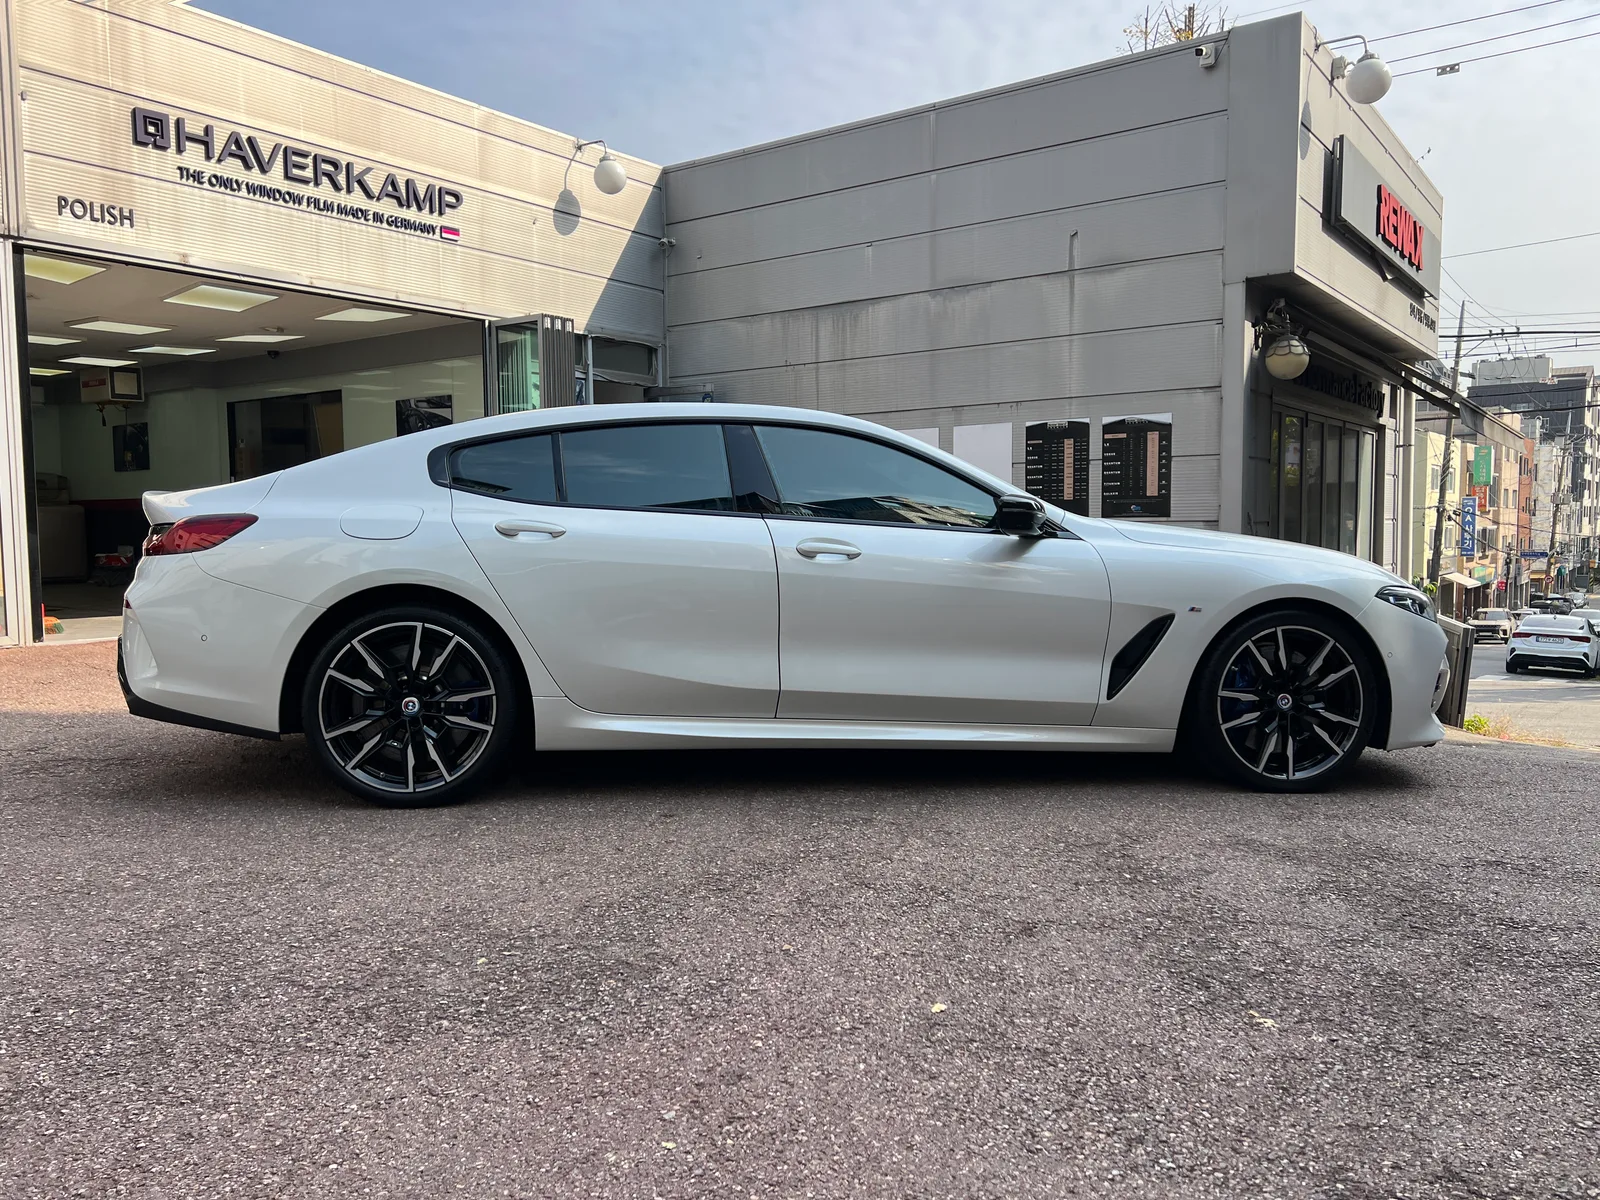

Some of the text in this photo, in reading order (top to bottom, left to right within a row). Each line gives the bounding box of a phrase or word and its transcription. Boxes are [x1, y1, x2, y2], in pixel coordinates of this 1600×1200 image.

[175, 116, 463, 216] HAVERKAMP
[176, 165, 438, 236] THE ONLY WINDOW FILM MADE IN GERMANY
[57, 195, 135, 229] POLISH
[1376, 183, 1424, 272] REWAX
